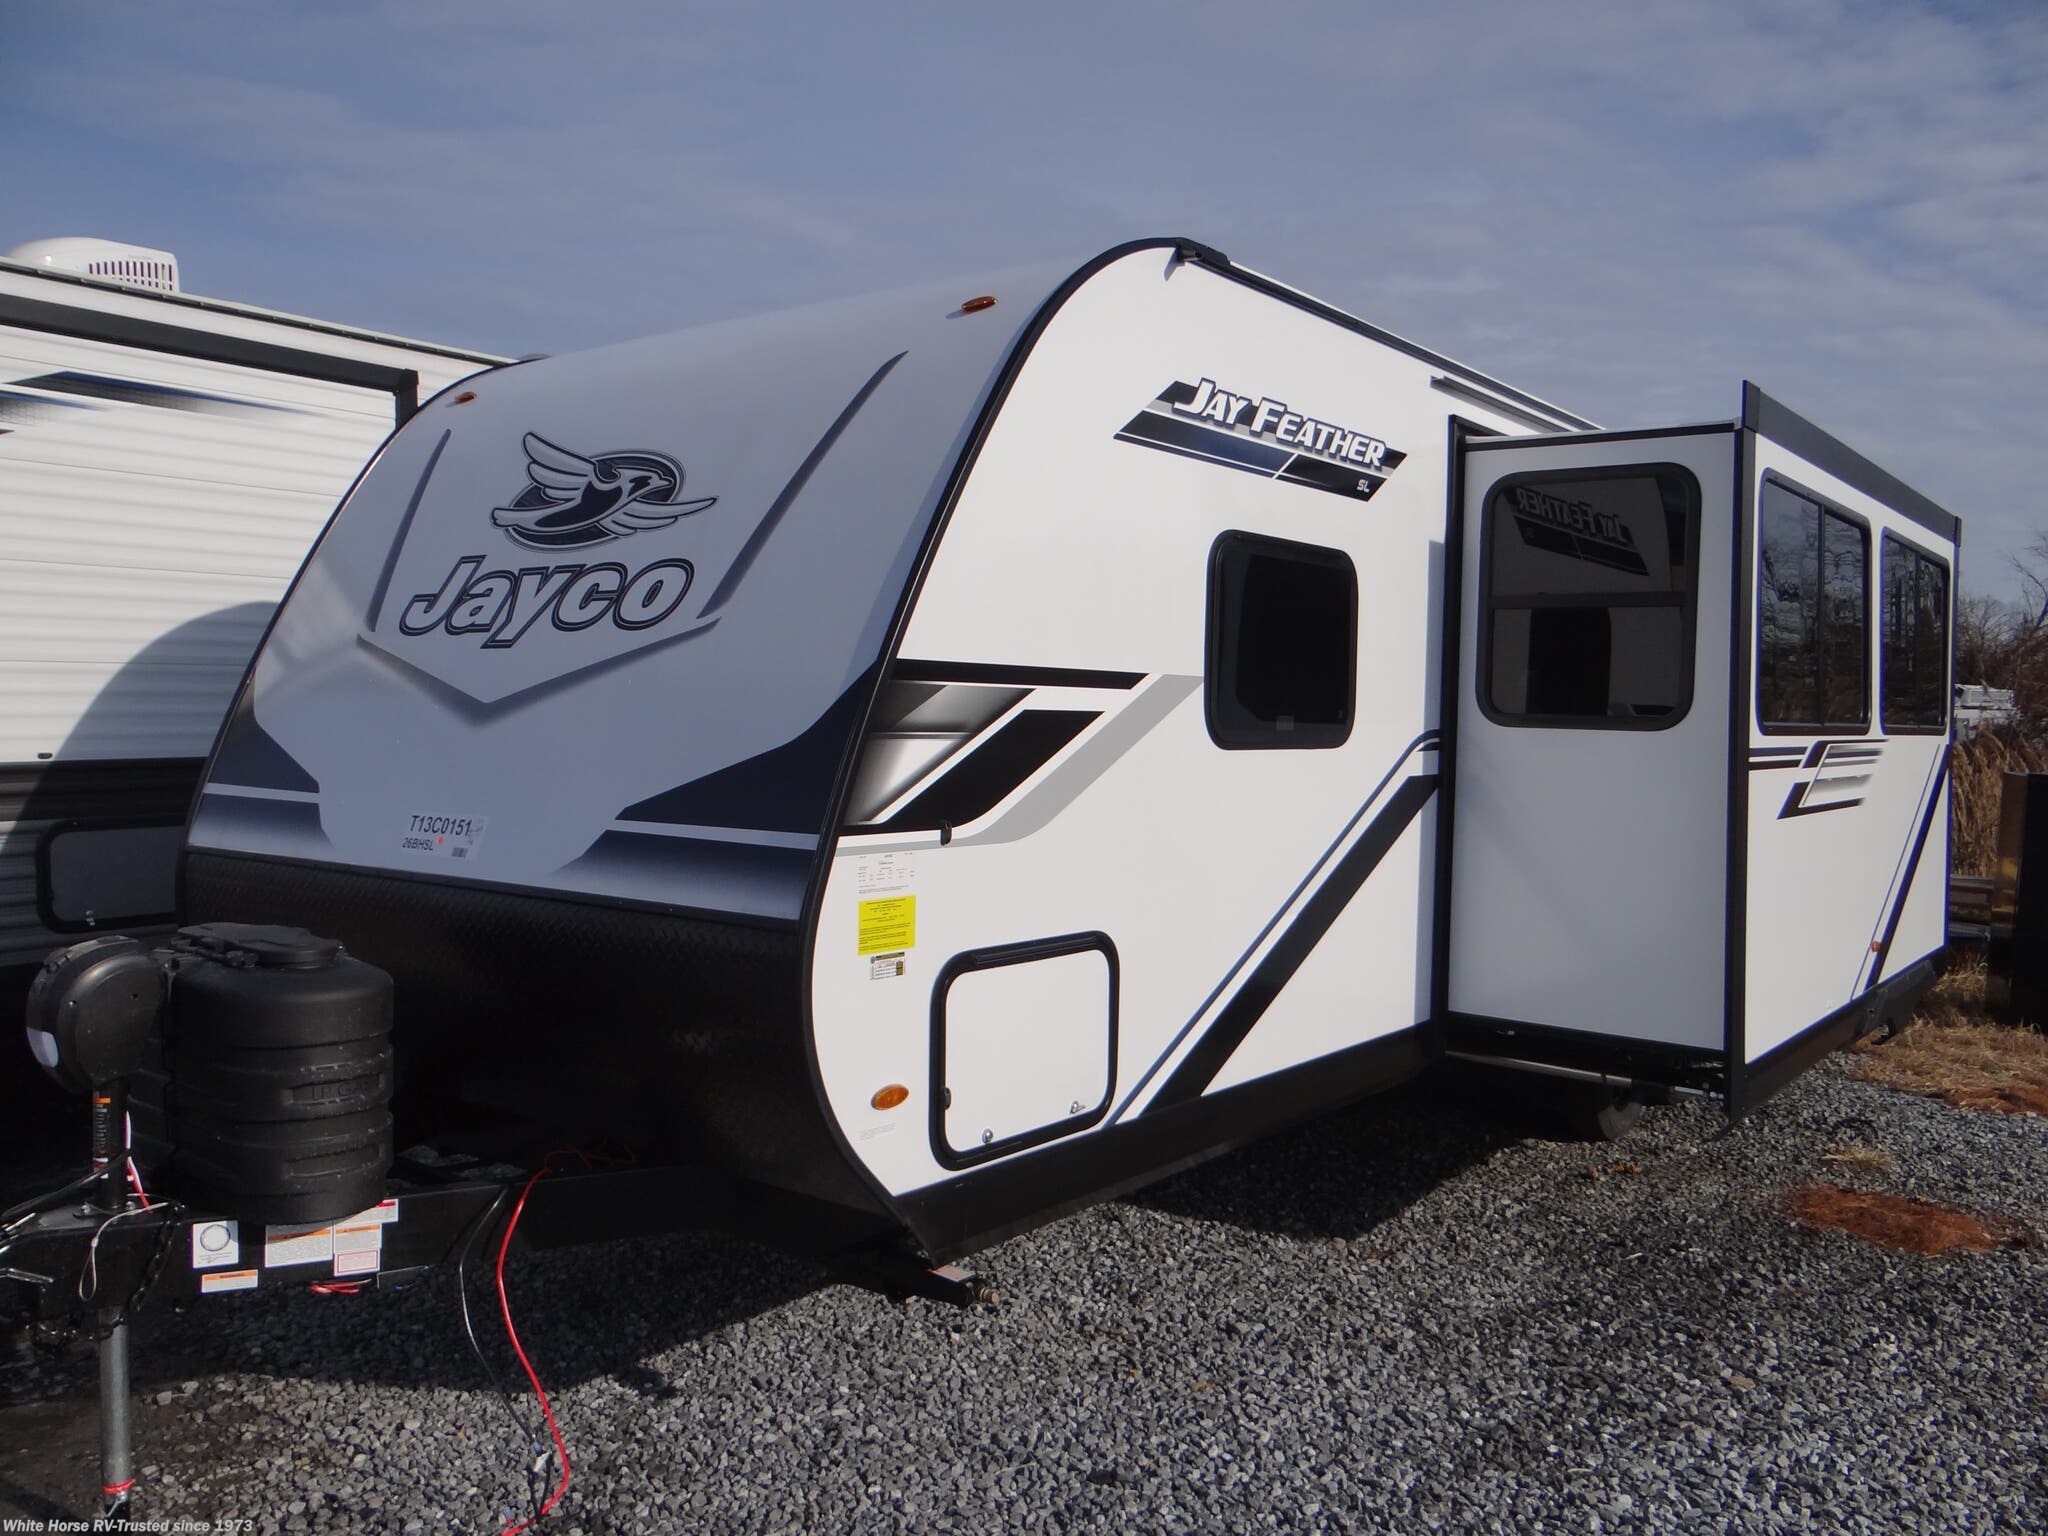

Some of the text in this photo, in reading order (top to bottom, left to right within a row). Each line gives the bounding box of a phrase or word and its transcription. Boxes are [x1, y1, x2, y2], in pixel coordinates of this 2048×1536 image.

[1172, 378, 1386, 468] JAY FEATHER
[1357, 479, 1370, 493] SL
[400, 554, 695, 649] Jayco
[410, 815, 473, 837] T13C0151
[401, 837, 434, 851] 26BHSL
